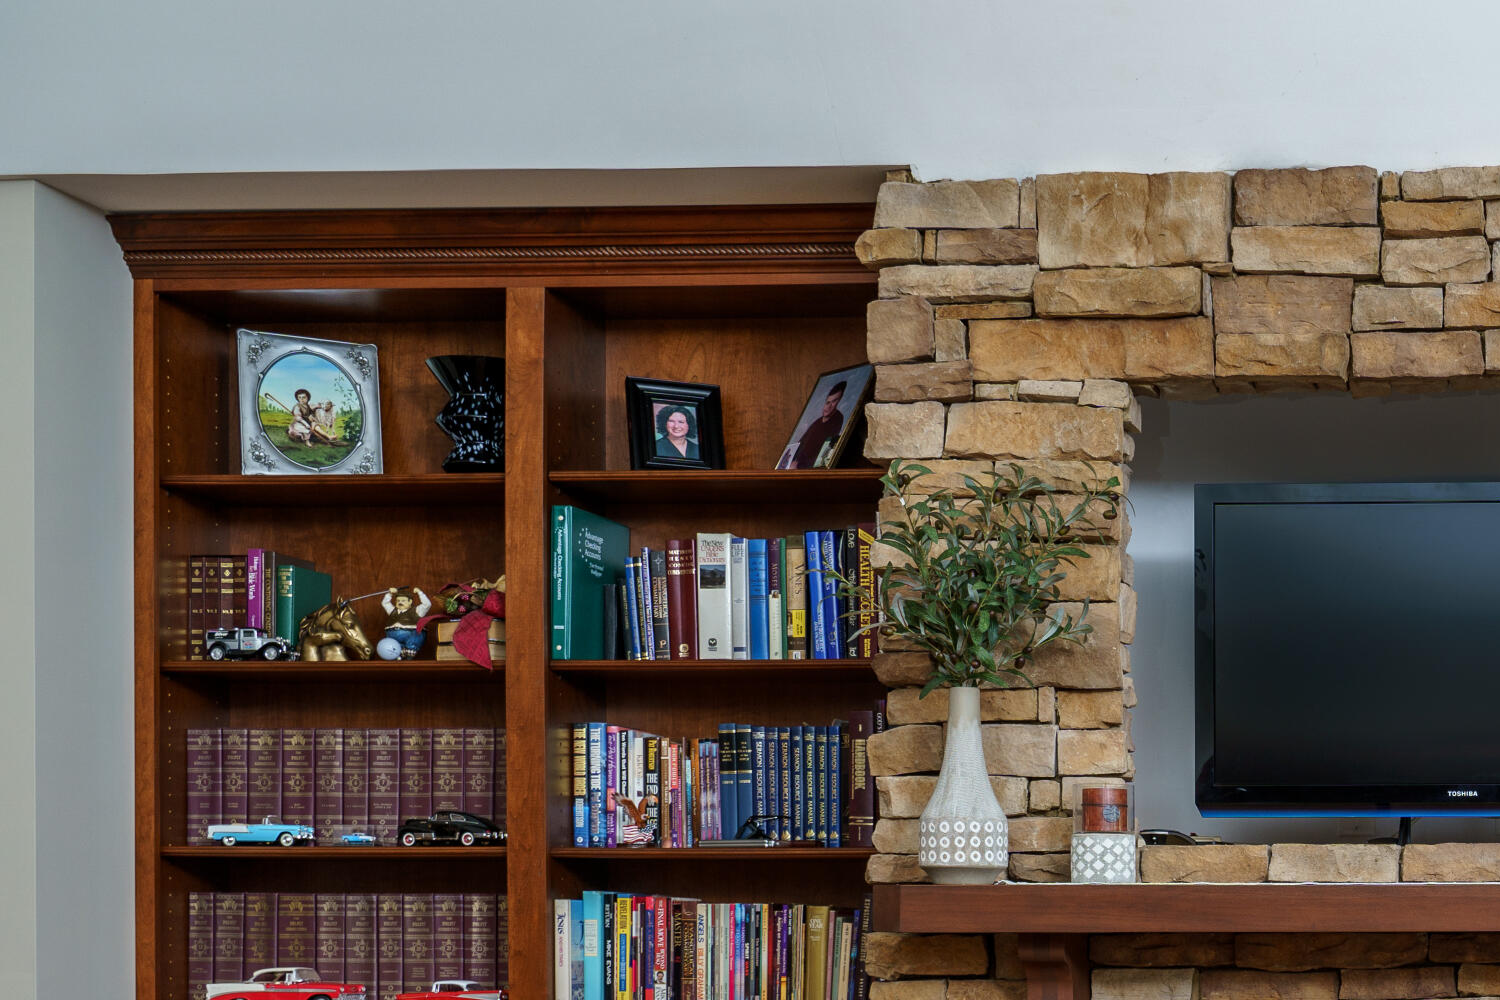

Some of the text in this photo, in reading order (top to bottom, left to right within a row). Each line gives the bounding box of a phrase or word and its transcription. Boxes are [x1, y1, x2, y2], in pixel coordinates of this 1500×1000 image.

[859, 545, 871, 587] HEALTH
[574, 727, 587, 739] THE
[574, 740, 587, 754] NEW
[590, 727, 601, 790] THE TURNING TIDE
[574, 755, 587, 776] WORLD
[854, 739, 866, 791] HANDBOOK
[646, 773, 658, 783] THE
[646, 784, 658, 795] END
[646, 808, 658, 817] THE
[619, 899, 628, 929] REVELATION
[657, 908, 665, 947] FINAL MOVE
[674, 912, 683, 947] MASTER
